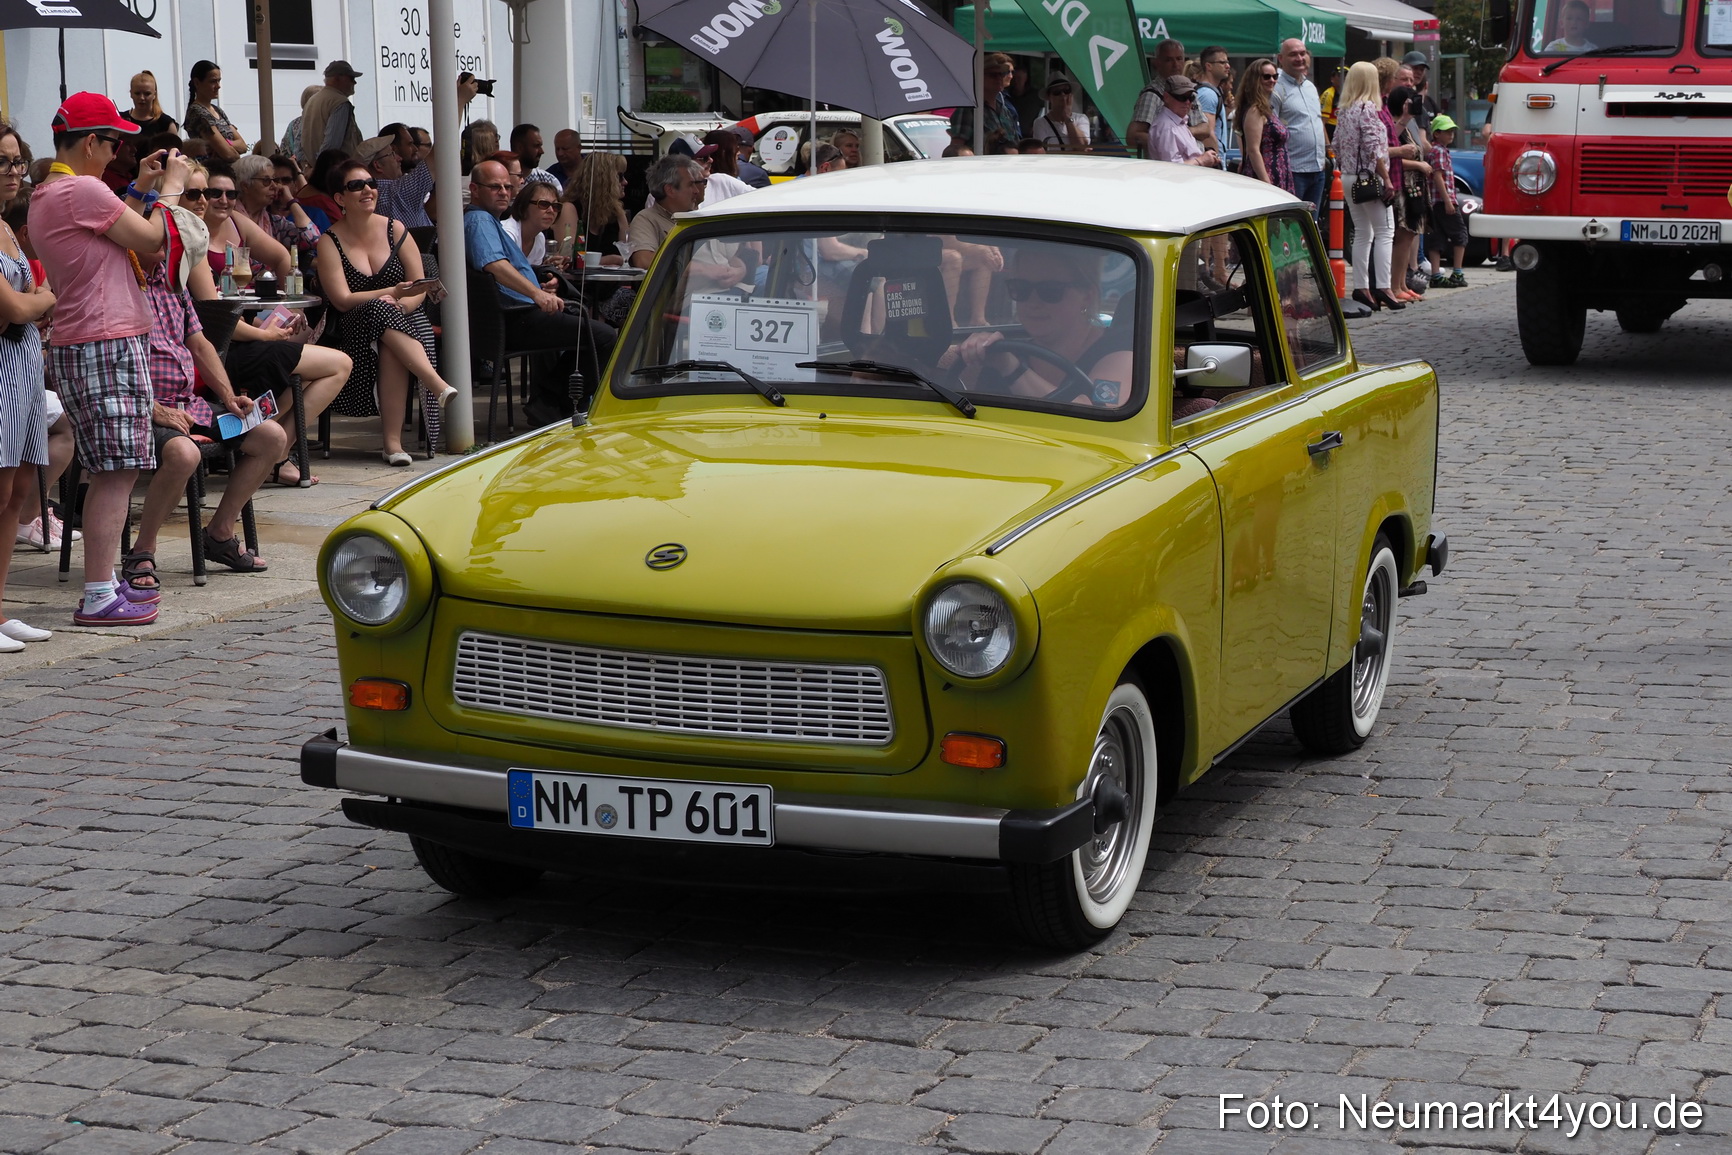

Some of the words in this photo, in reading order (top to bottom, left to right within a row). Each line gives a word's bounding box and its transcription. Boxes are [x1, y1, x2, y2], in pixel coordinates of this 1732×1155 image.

[400, 7, 421, 36] 30
[1308, 22, 1326, 44] DEKRA
[381, 45, 416, 75] Bang
[420, 47, 430, 70] &
[394, 80, 406, 102] in
[775, 141, 783, 151] 6
[1631, 224, 1649, 239] NM
[1660, 224, 1678, 240] LO
[1682, 225, 1719, 241] 202H
[902, 282, 916, 291] NEW
[887, 292, 905, 301] CARS.
[891, 300, 901, 309] AM
[901, 298, 922, 308] RIDING
[888, 309, 900, 318] OLD
[750, 318, 794, 344] 327
[517, 805, 527, 818] D
[535, 779, 588, 826] NM
[618, 785, 673, 831] TP
[685, 790, 767, 837] 601
